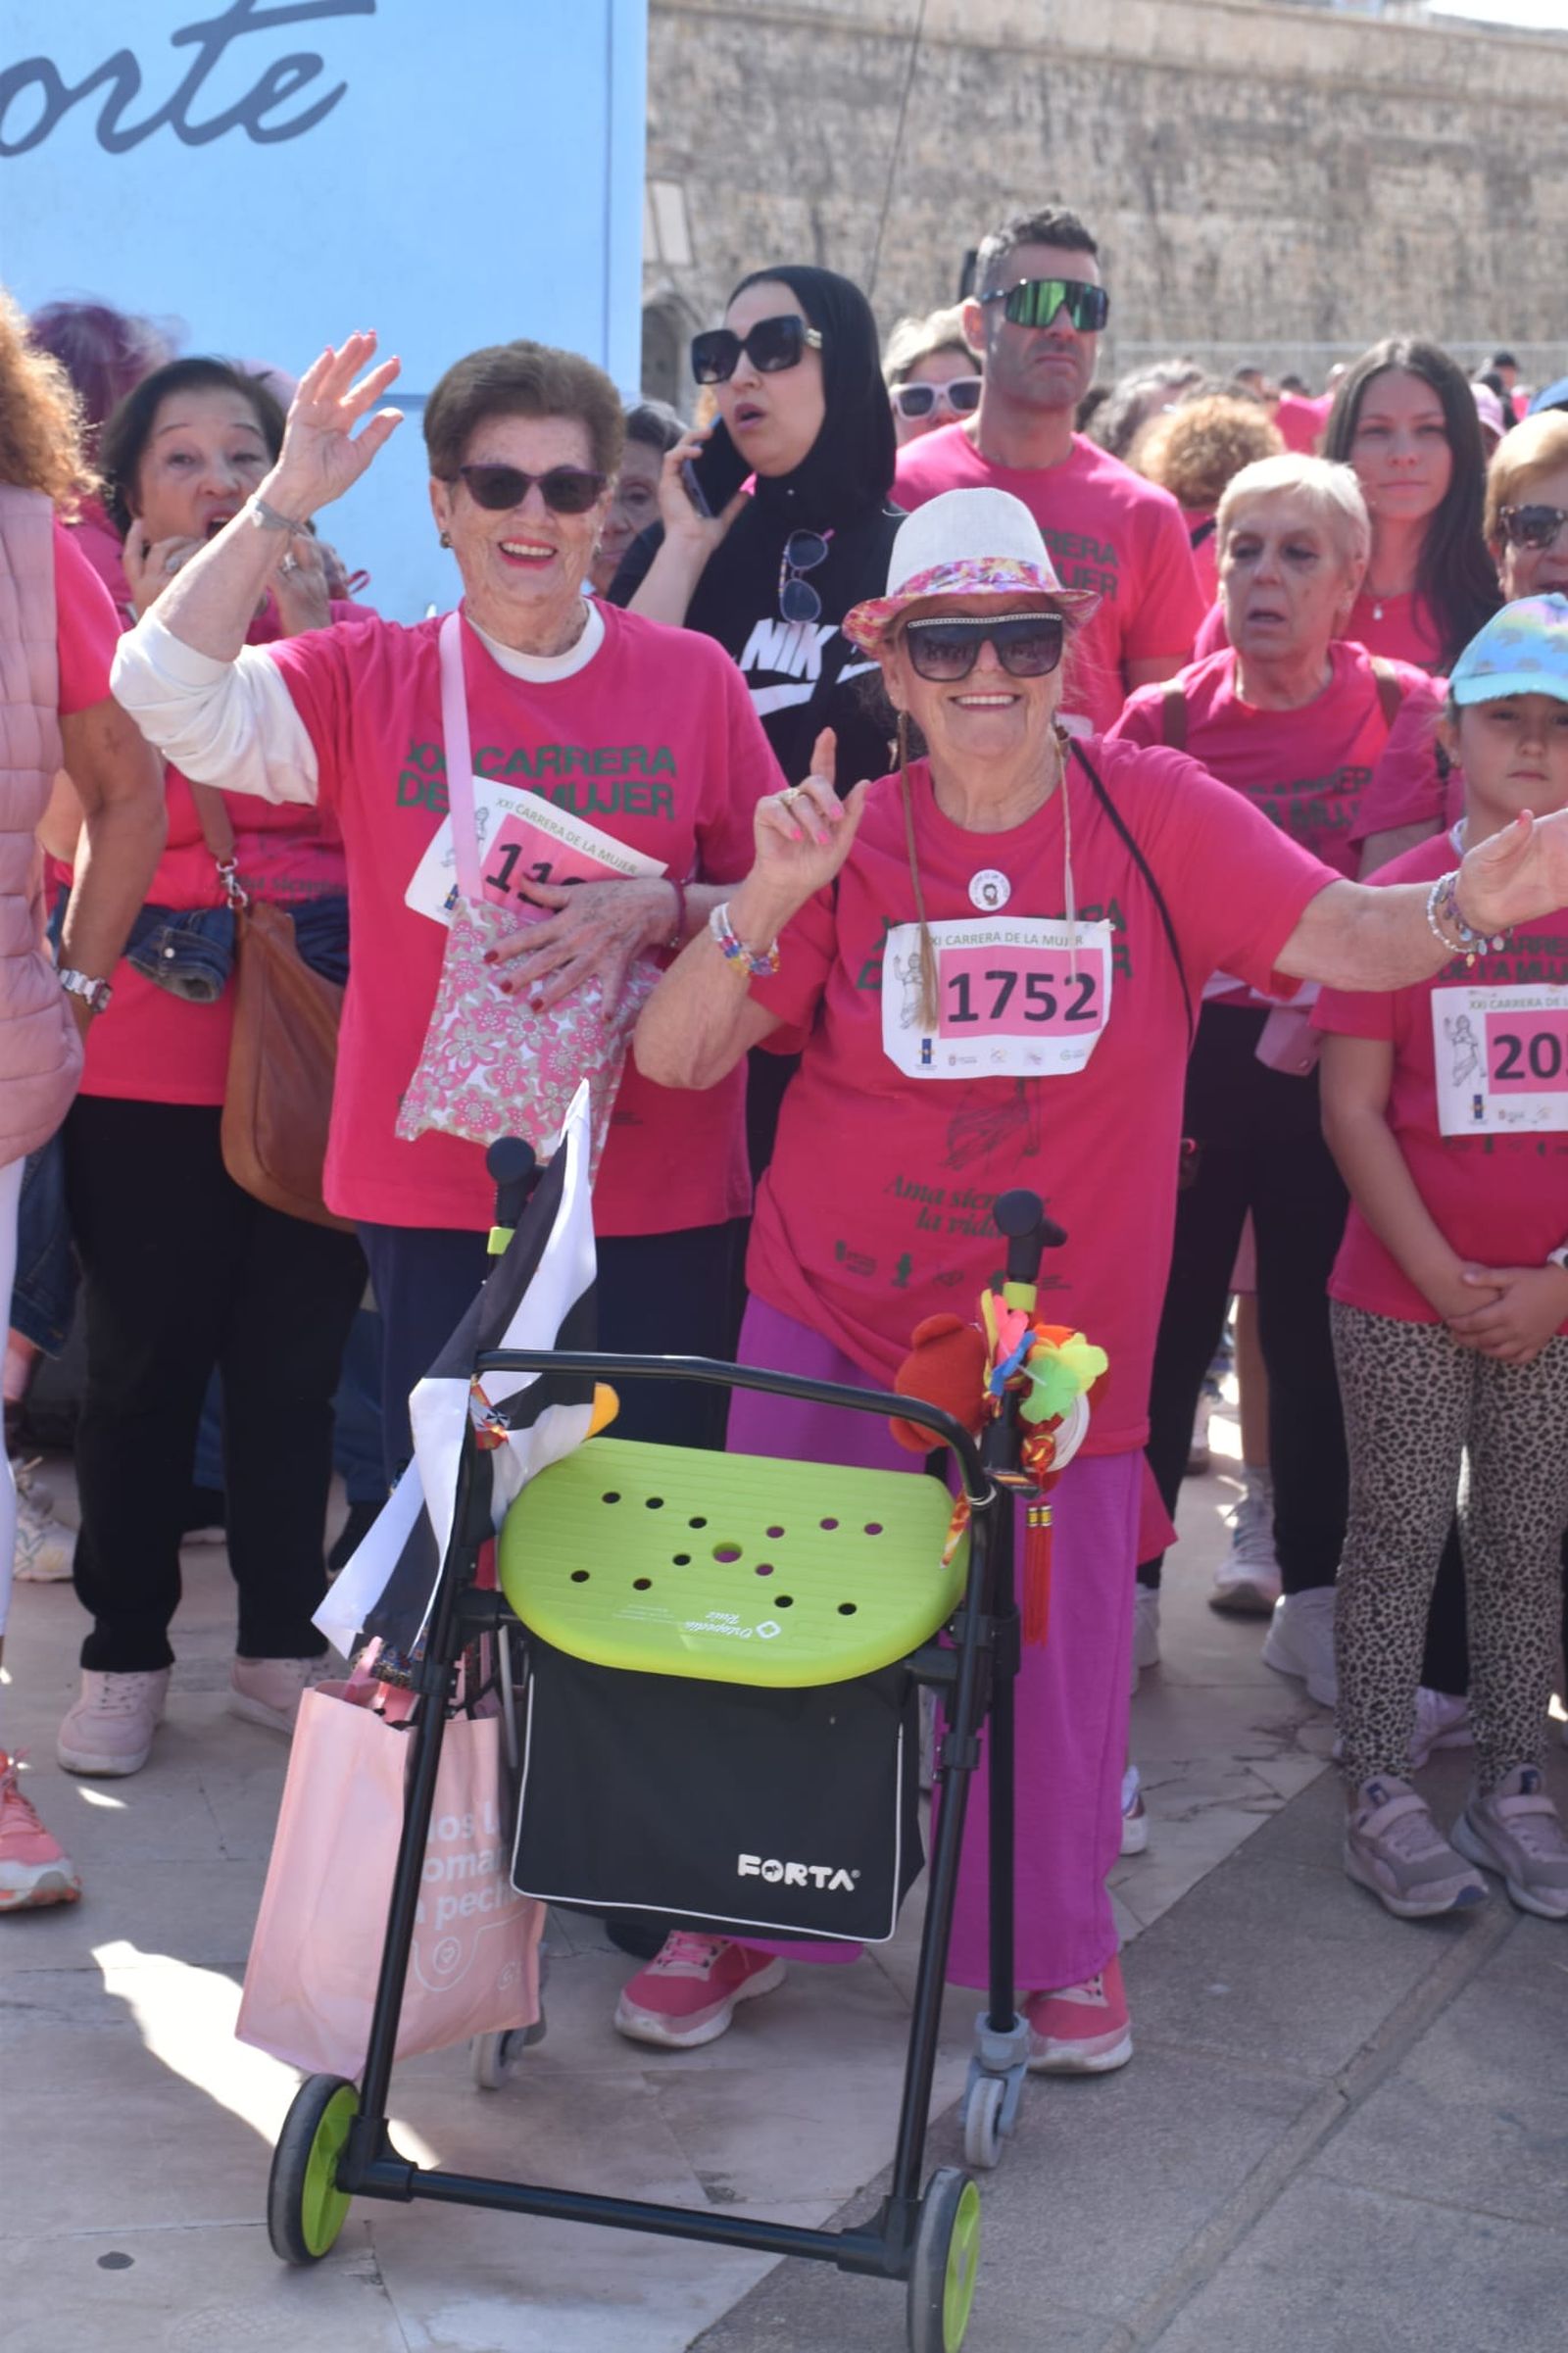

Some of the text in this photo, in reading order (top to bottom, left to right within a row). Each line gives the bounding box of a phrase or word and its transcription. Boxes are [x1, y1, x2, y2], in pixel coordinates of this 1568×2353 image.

[739, 617, 840, 680] NIK
[474, 745, 677, 777] CARRERA
[396, 769, 450, 815] DE
[514, 803, 565, 837] CARRERA
[565, 830, 581, 846] DE
[582, 840, 597, 857] LA
[598, 848, 639, 875] MUJER
[946, 931, 1001, 947] CARRERA
[1005, 932, 1021, 944] DE
[1025, 934, 1039, 946] LA
[1042, 934, 1083, 947] MUJR
[948, 970, 1098, 1022] 1752
[1490, 998, 1542, 1009] CARRERA
[1545, 998, 1560, 1007] DE
[1494, 1033, 1568, 1080] 20
[738, 1853, 856, 1891] FORTA
